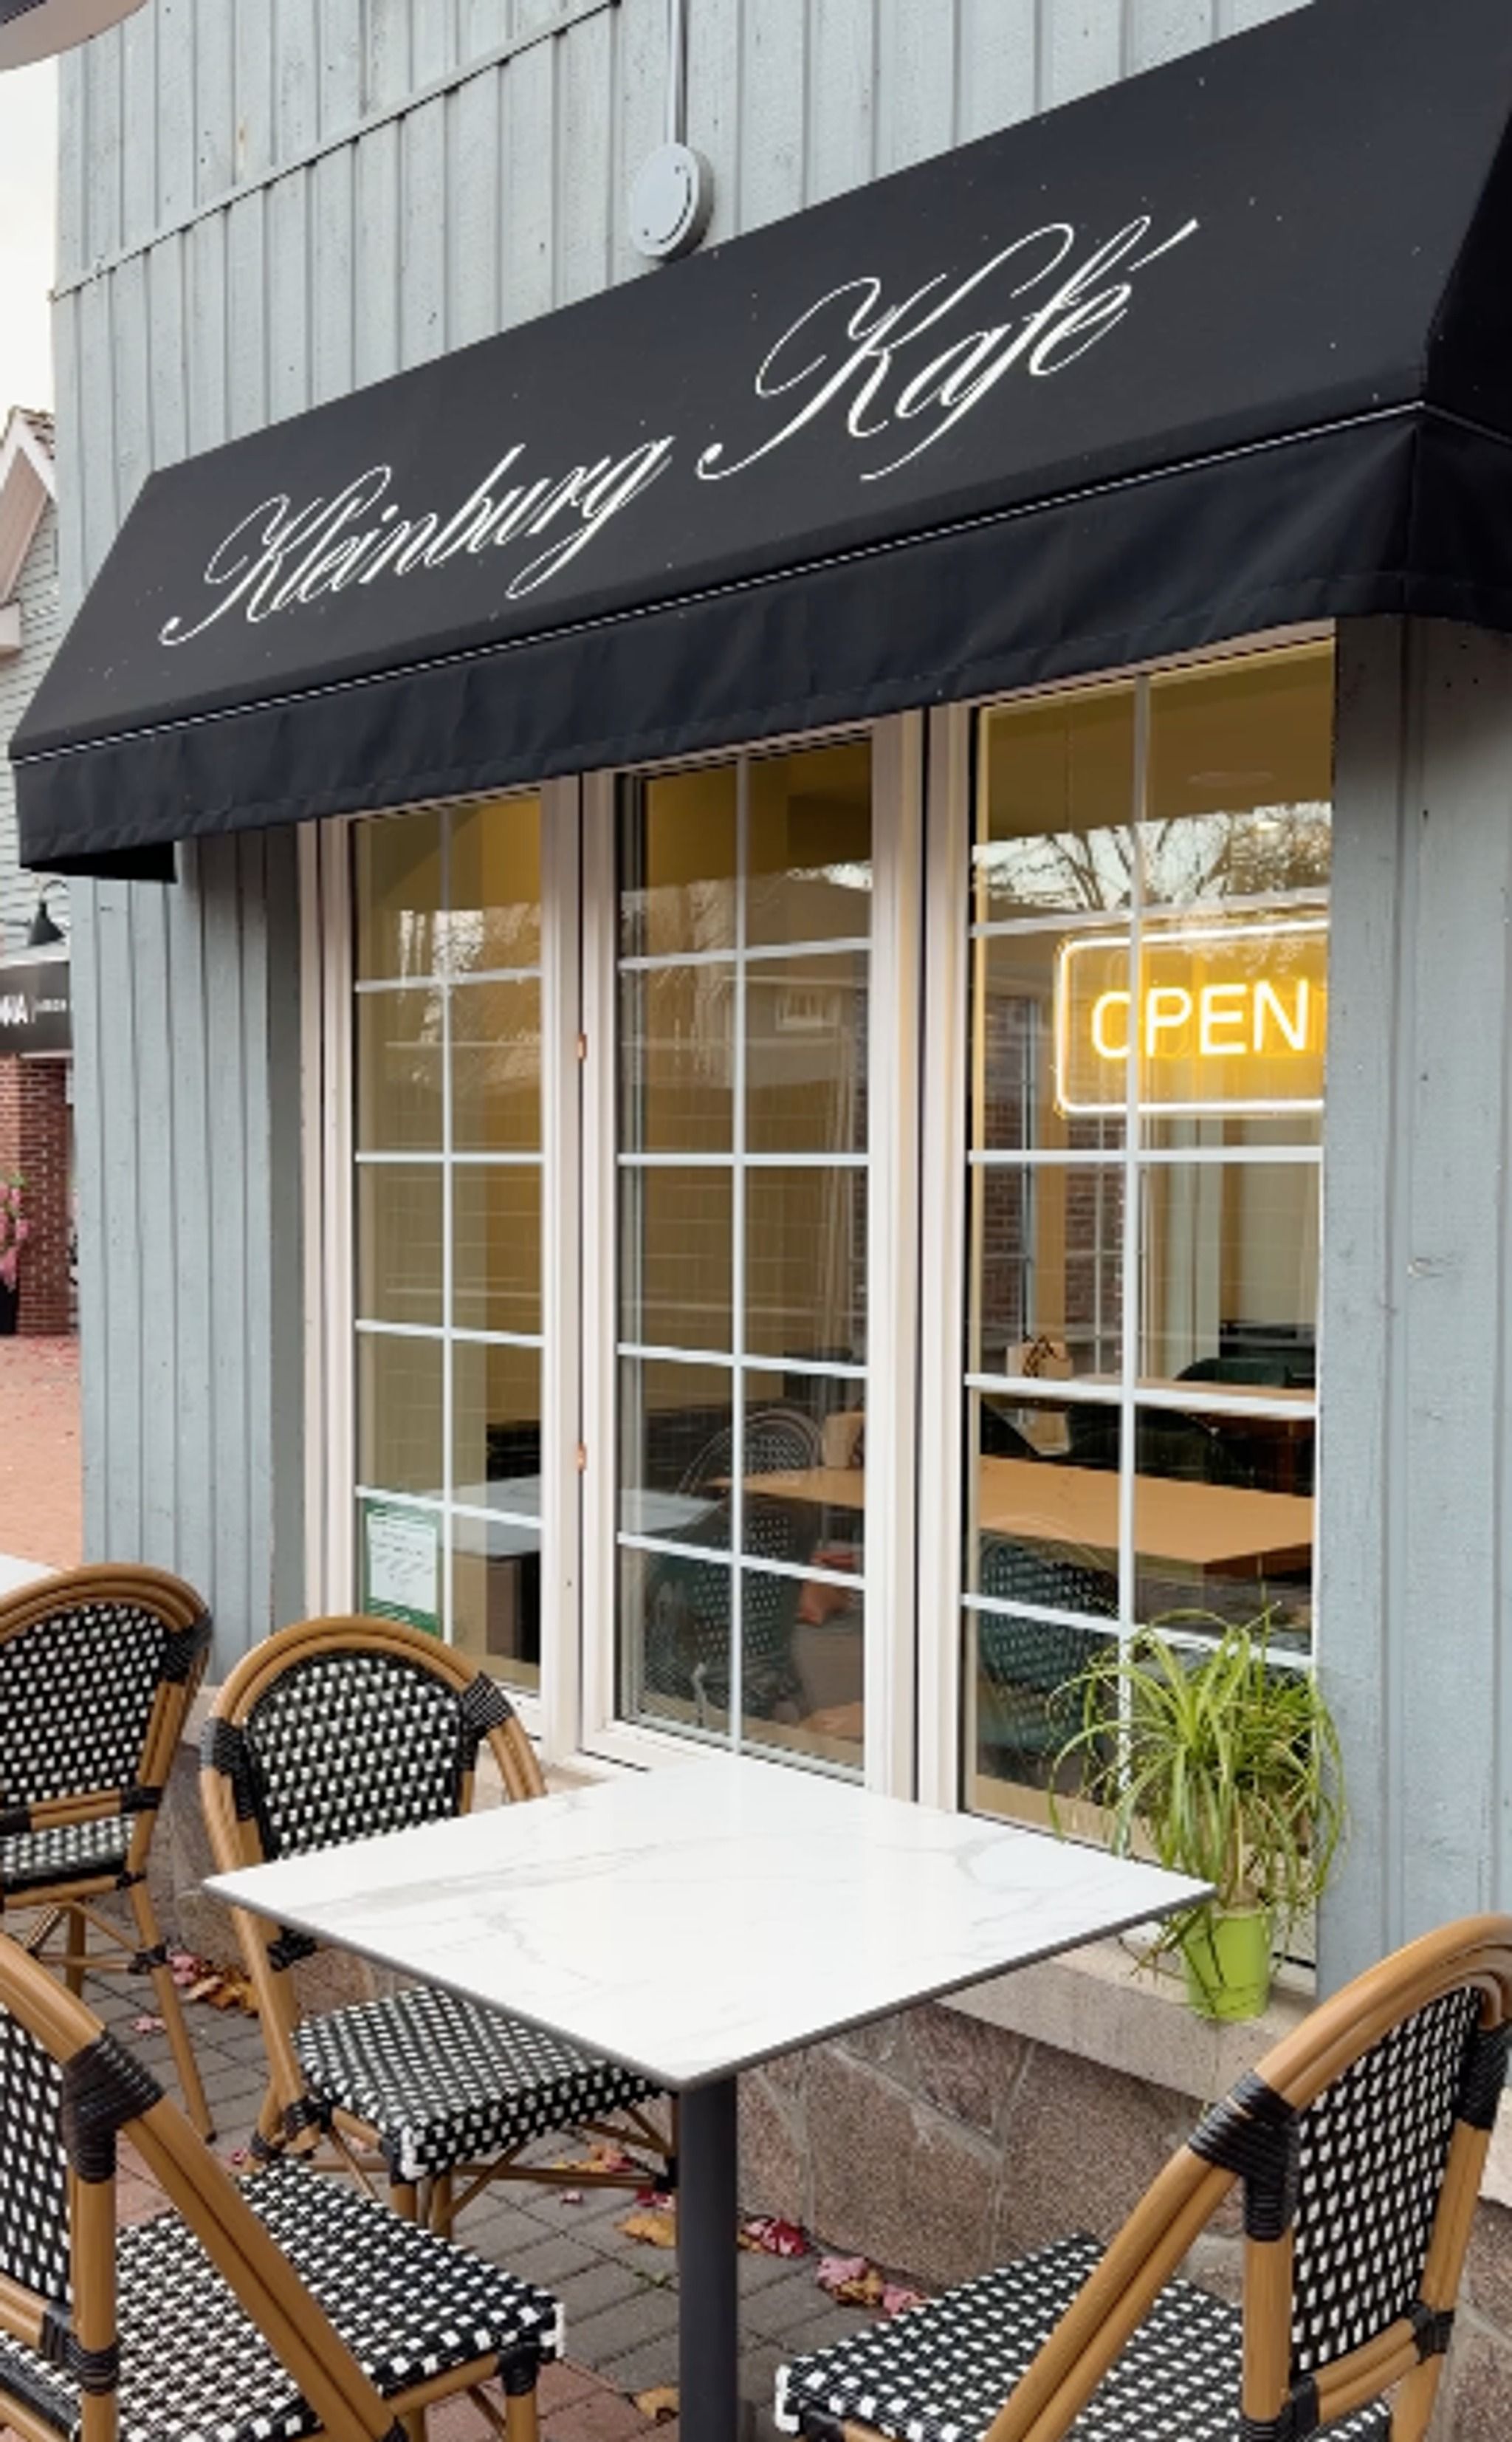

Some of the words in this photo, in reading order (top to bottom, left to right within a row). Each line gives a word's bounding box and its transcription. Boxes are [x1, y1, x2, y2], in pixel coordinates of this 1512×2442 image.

[159, 436, 676, 645] Kleinburg
[697, 215, 1198, 481] Kafé
[1091, 978, 1310, 1058] OPEN
